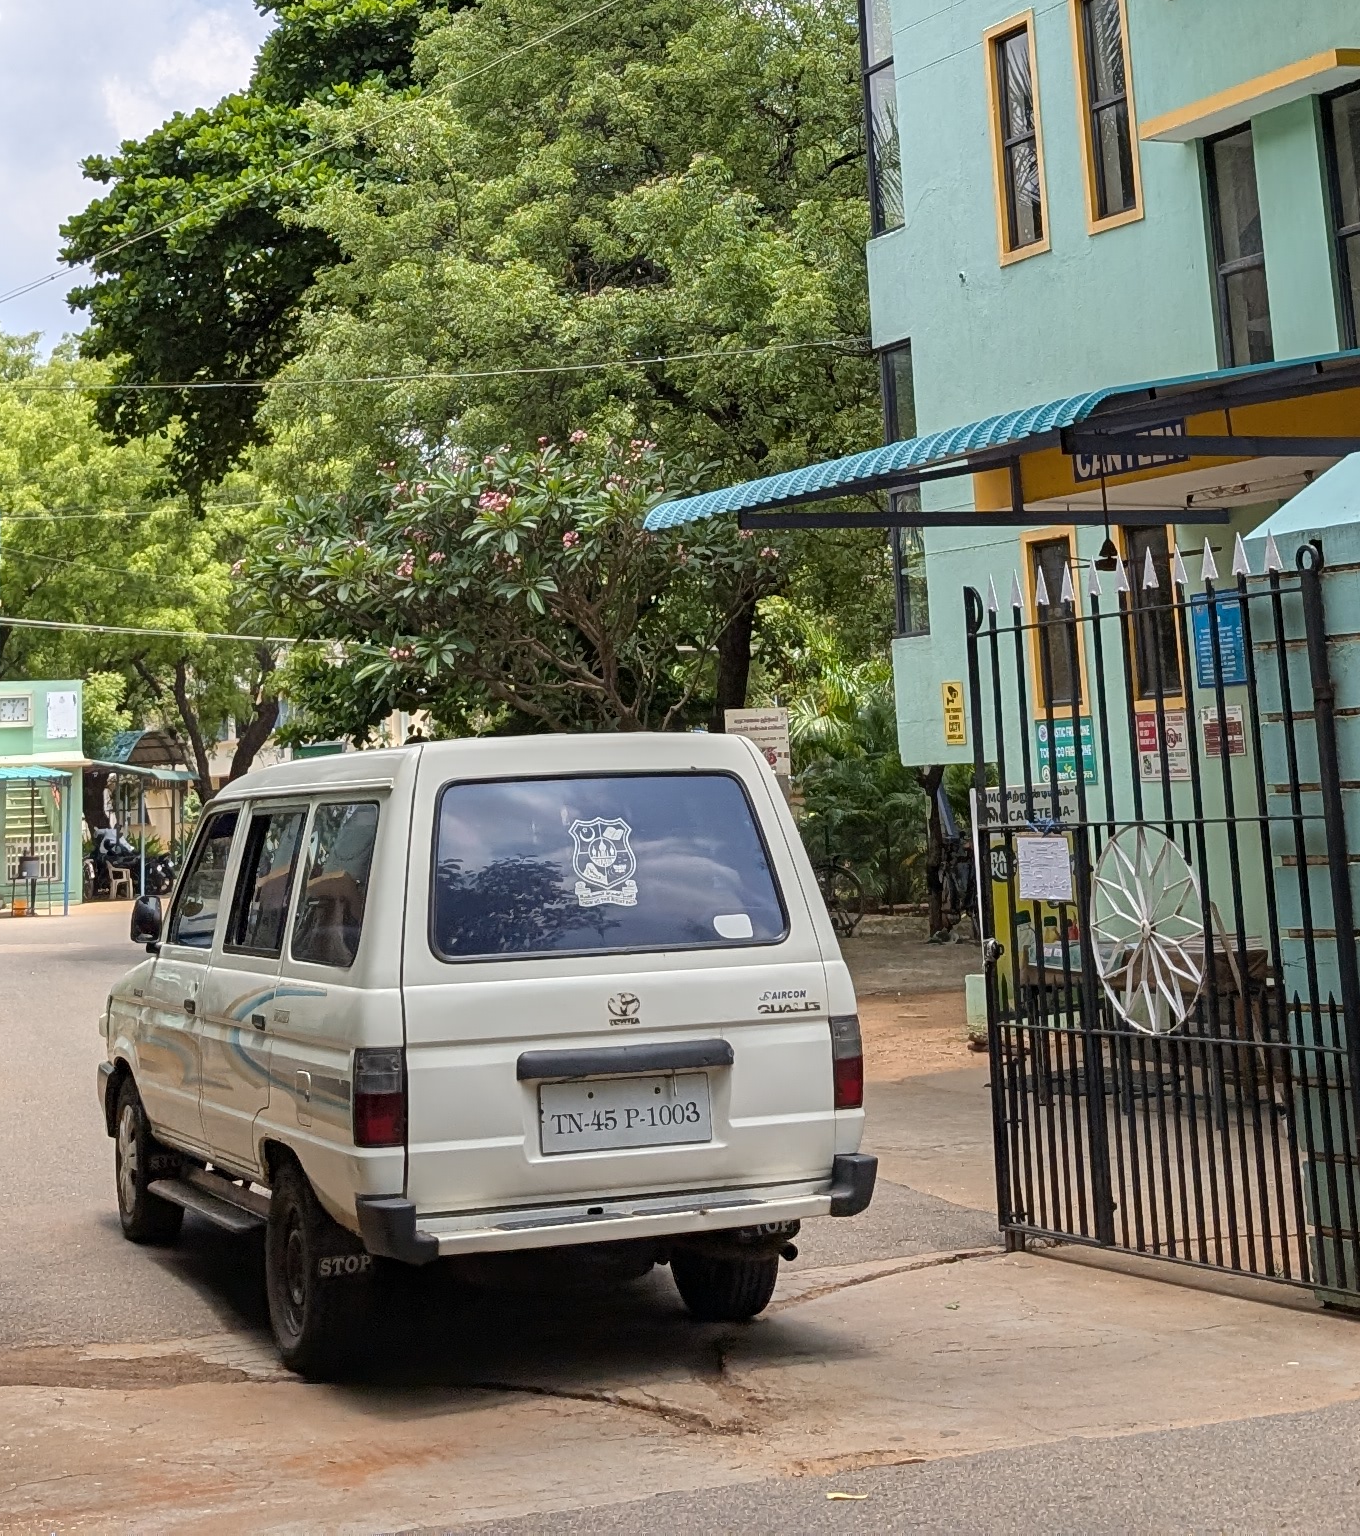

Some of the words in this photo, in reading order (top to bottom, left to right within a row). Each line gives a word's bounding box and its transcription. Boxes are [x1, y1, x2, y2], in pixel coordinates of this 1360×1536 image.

[772, 990, 807, 1000] AIRCON
[550, 1109, 617, 1135] TN-45
[624, 1101, 701, 1129] P-1003
[320, 1255, 371, 1277] STOP
